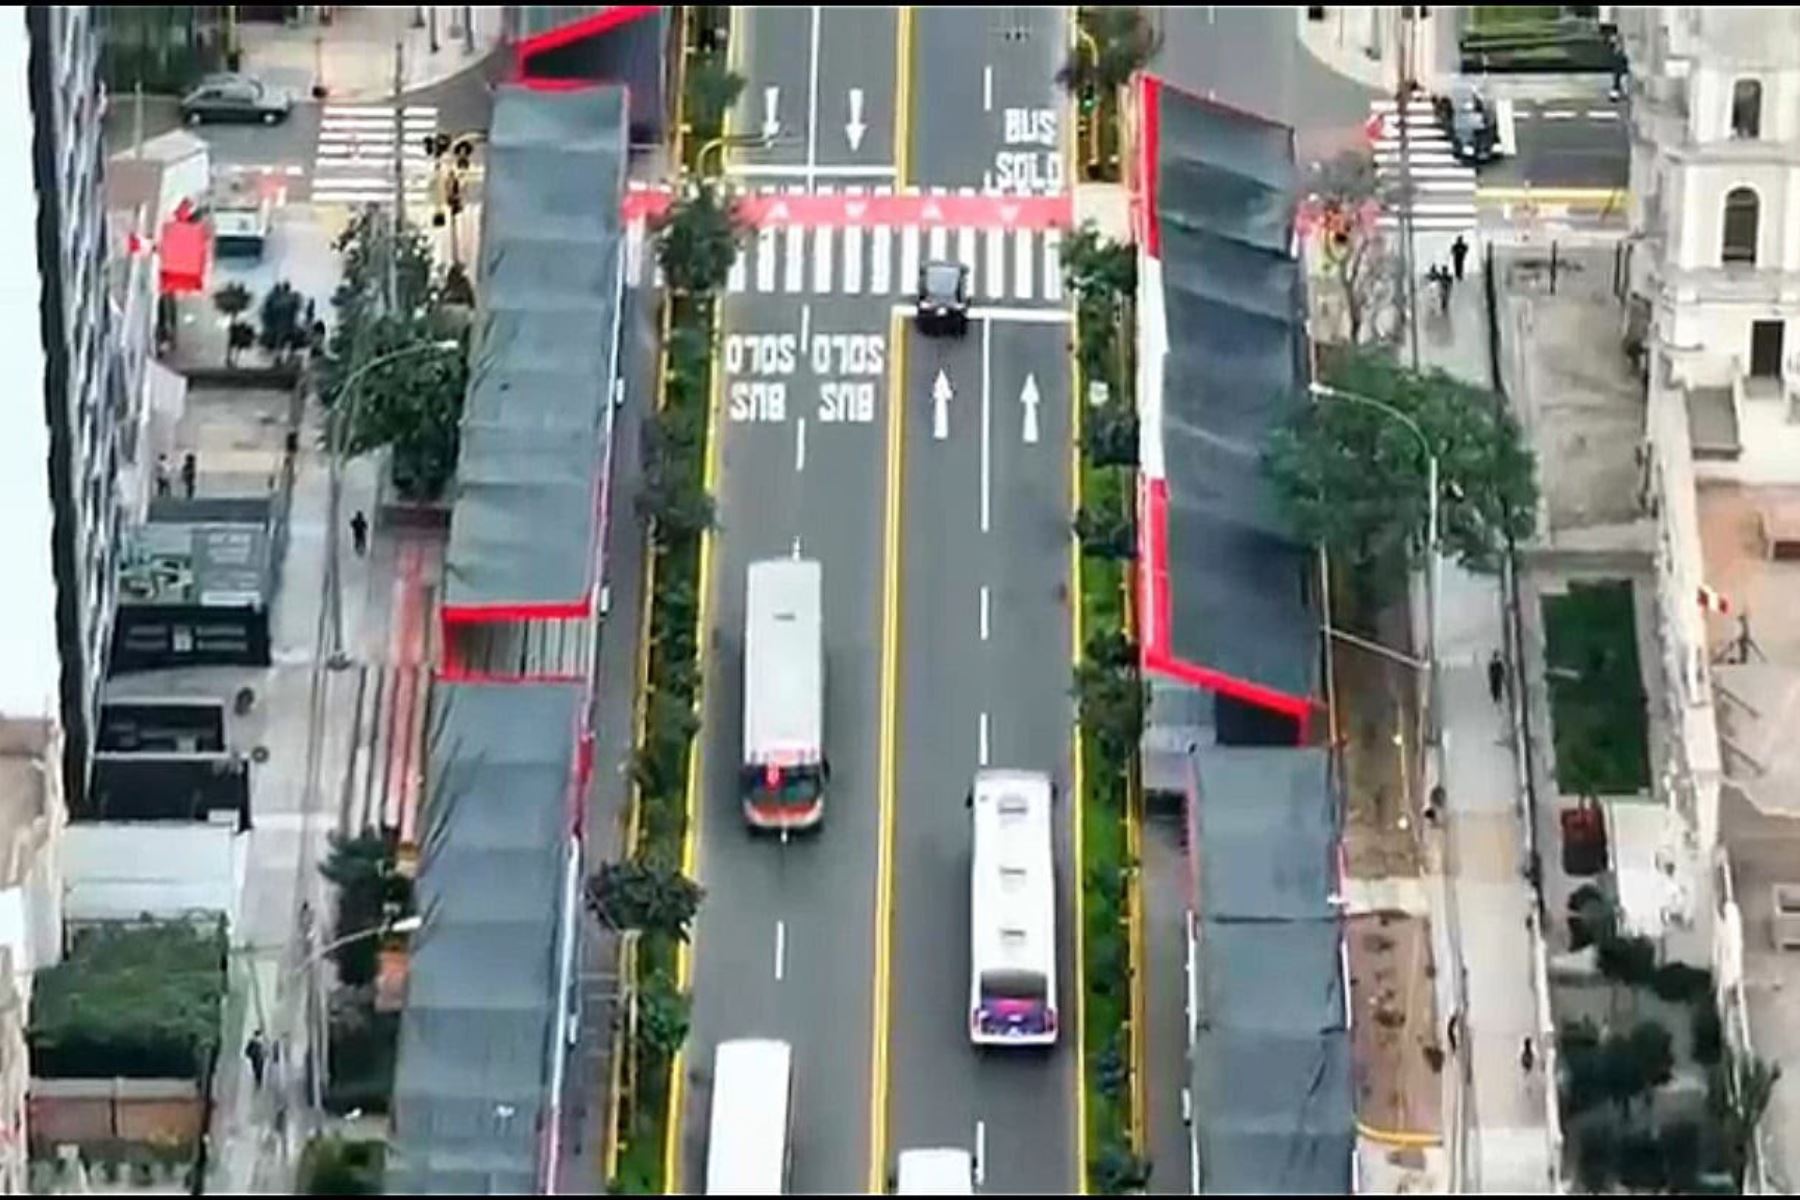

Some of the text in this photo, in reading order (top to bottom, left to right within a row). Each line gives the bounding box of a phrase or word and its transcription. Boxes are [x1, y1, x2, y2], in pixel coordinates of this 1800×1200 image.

[1004, 108, 1056, 144] BUS
[995, 151, 1063, 190] SOLO
[726, 334, 796, 374] SOLO
[812, 334, 885, 374] SOLO
[730, 382, 786, 422] BUS
[819, 382, 874, 422] BUS
